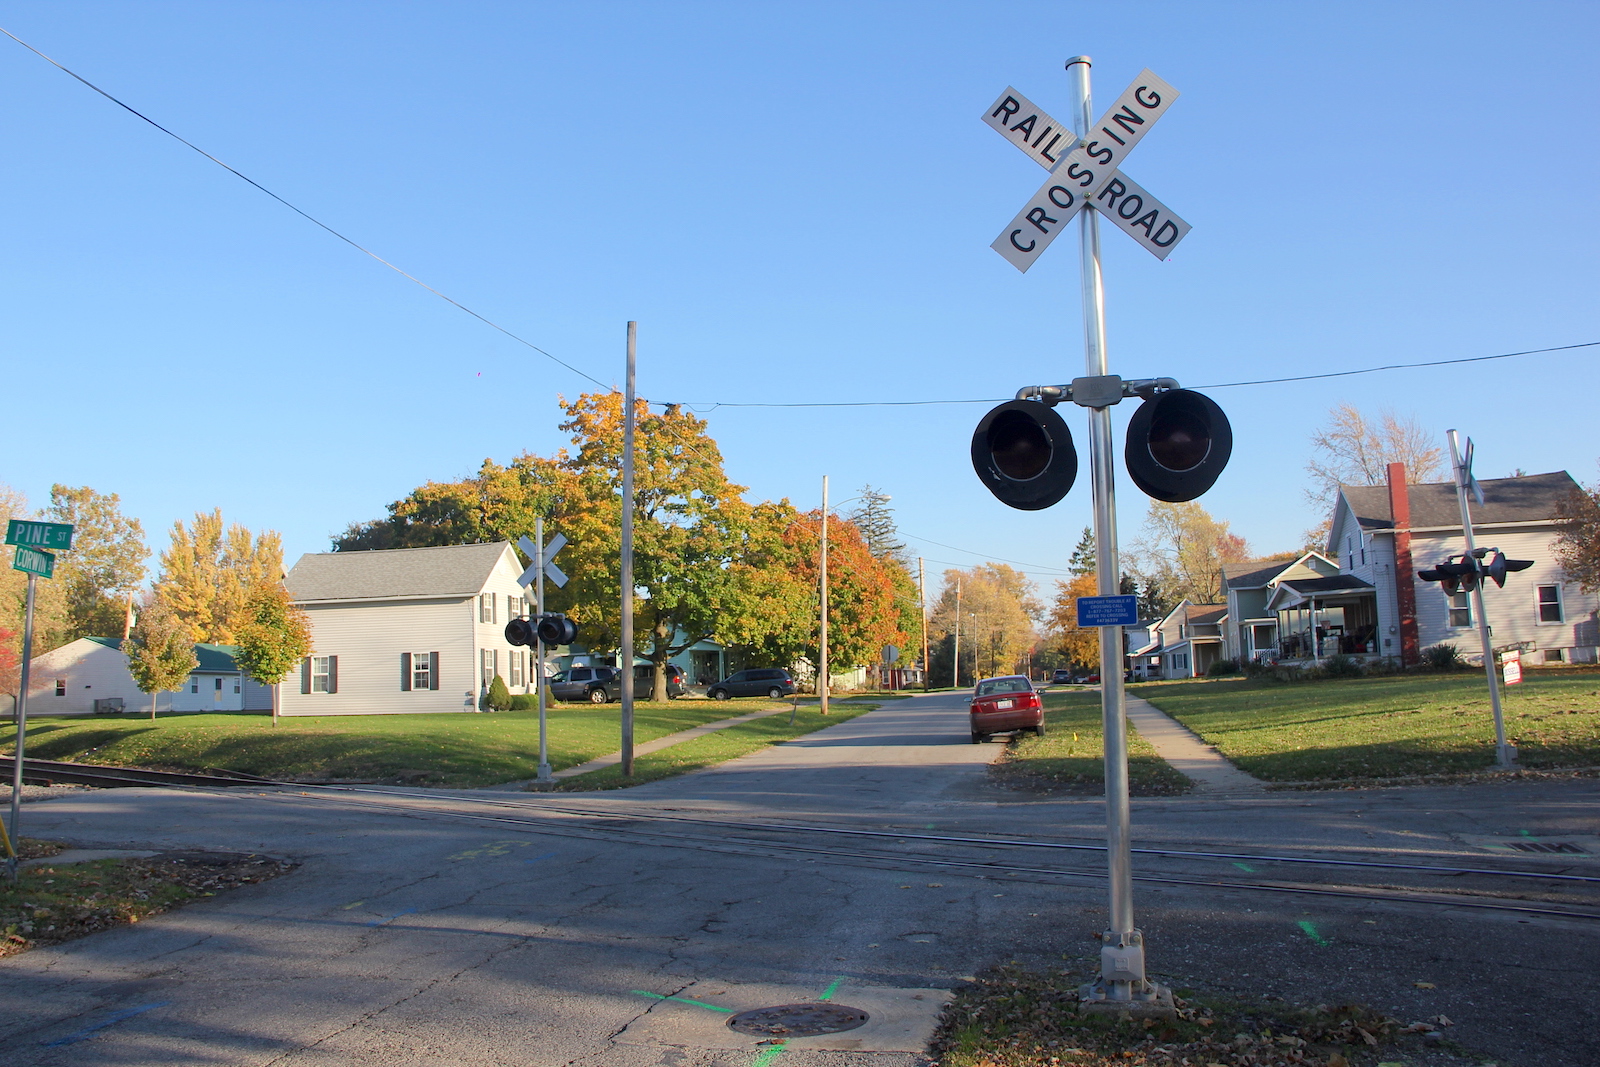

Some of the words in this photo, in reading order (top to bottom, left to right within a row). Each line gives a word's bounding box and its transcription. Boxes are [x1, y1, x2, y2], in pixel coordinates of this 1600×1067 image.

[992, 95, 1062, 163] RAIL
[1097, 177, 1179, 248] ROAD
[1009, 85, 1162, 253] CROSSING
[14, 523, 52, 545] PINE
[57, 531, 67, 542] ST
[16, 548, 48, 574] CORWIN
